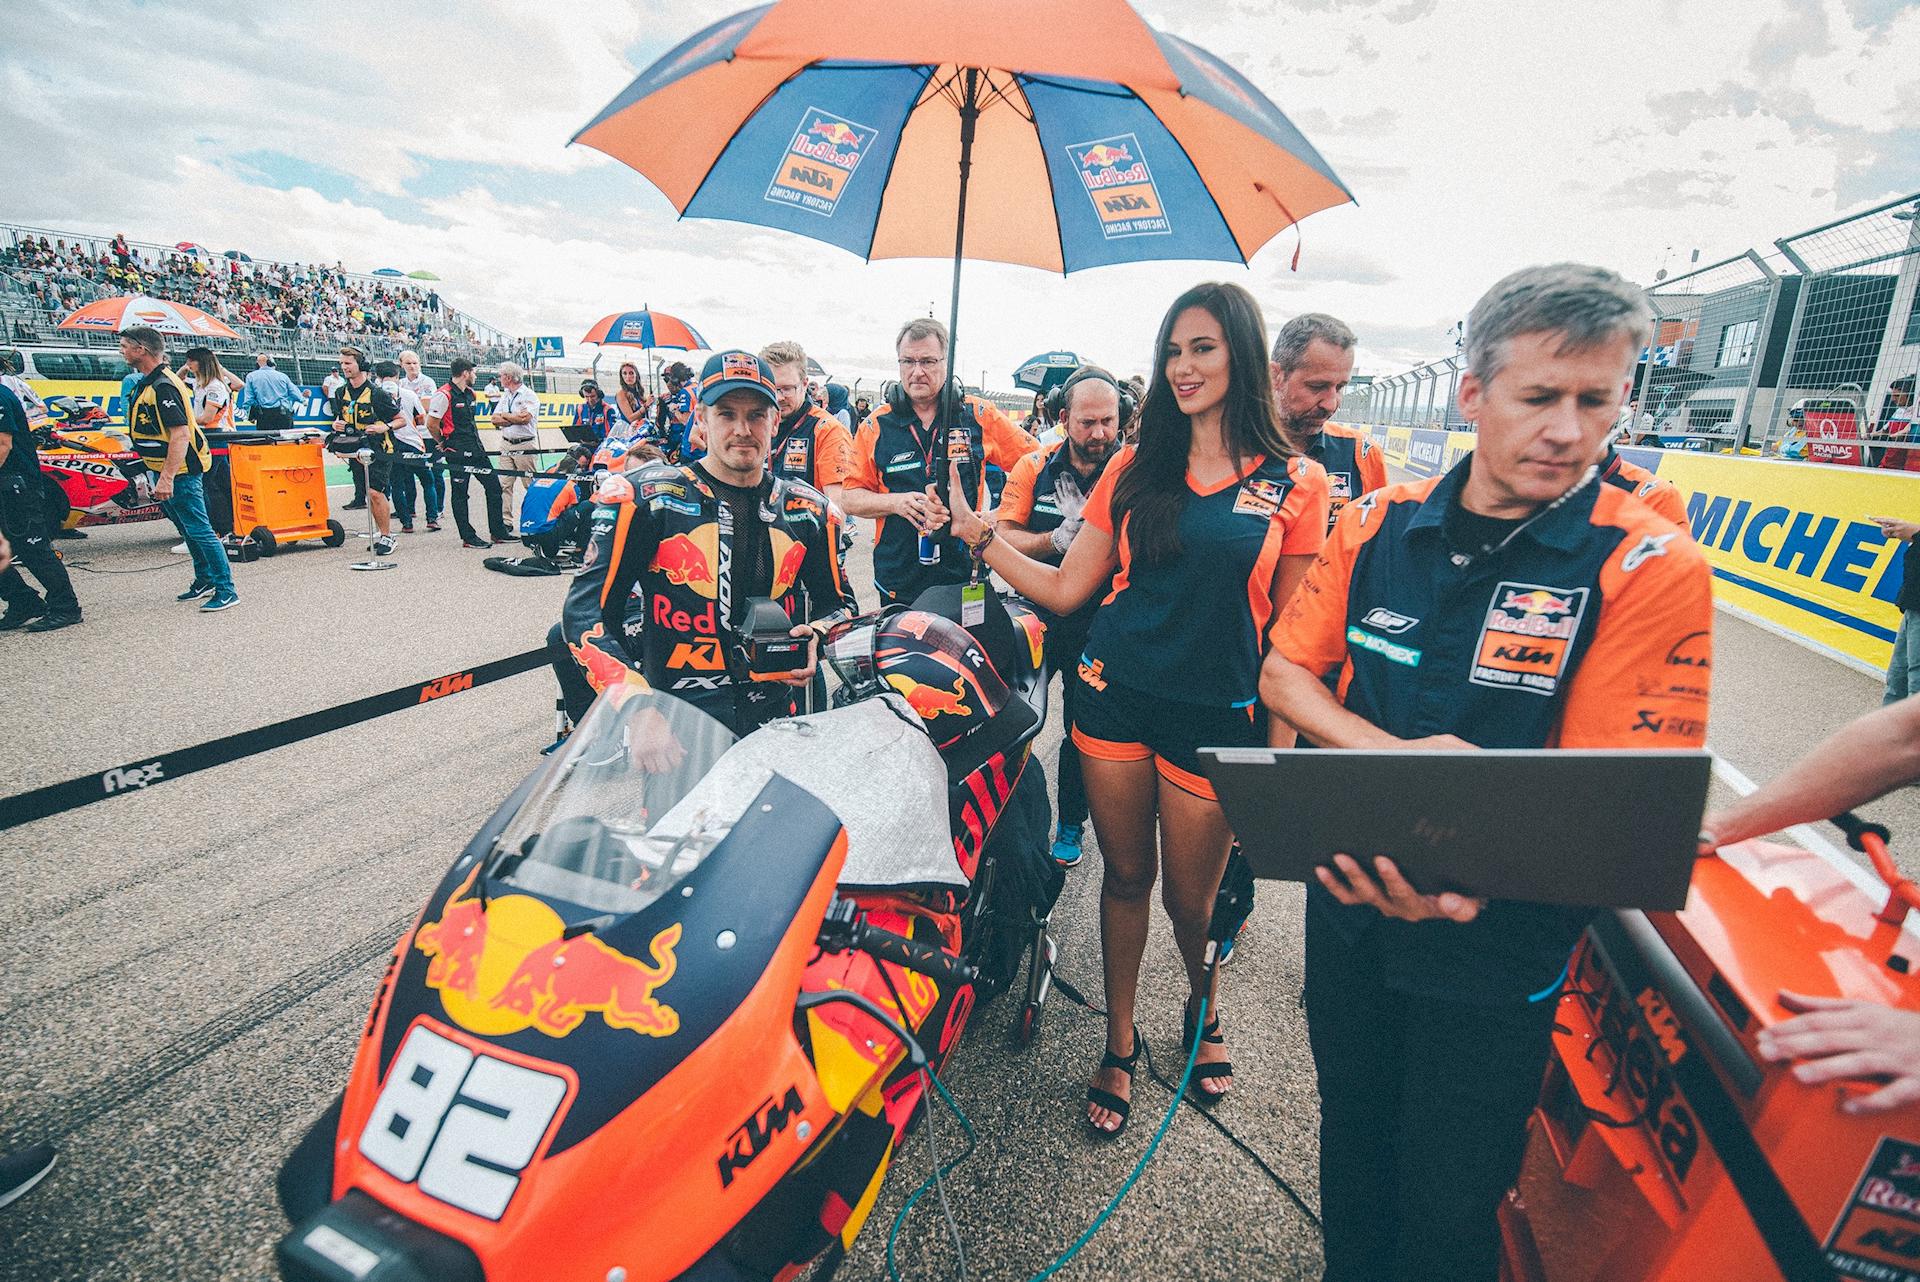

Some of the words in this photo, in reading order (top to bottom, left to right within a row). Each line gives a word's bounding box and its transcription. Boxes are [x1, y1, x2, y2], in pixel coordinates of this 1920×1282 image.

[1811, 443, 1853, 456] PRAMAC
[464, 465, 492, 475] TECH3
[1687, 491, 1910, 606] MICHE
[719, 541, 733, 631] IXON
[653, 593, 717, 635] Red
[666, 637, 726, 671] KT
[1493, 642, 1554, 665] KTM
[419, 672, 473, 704] KTM
[671, 675, 733, 690] IX
[1077, 662, 1108, 692] KTM
[103, 762, 164, 793] flex
[953, 751, 1011, 882] ull
[1636, 985, 1687, 1065] KTM
[358, 1023, 568, 1222] 82
[718, 1085, 805, 1189] KTM
